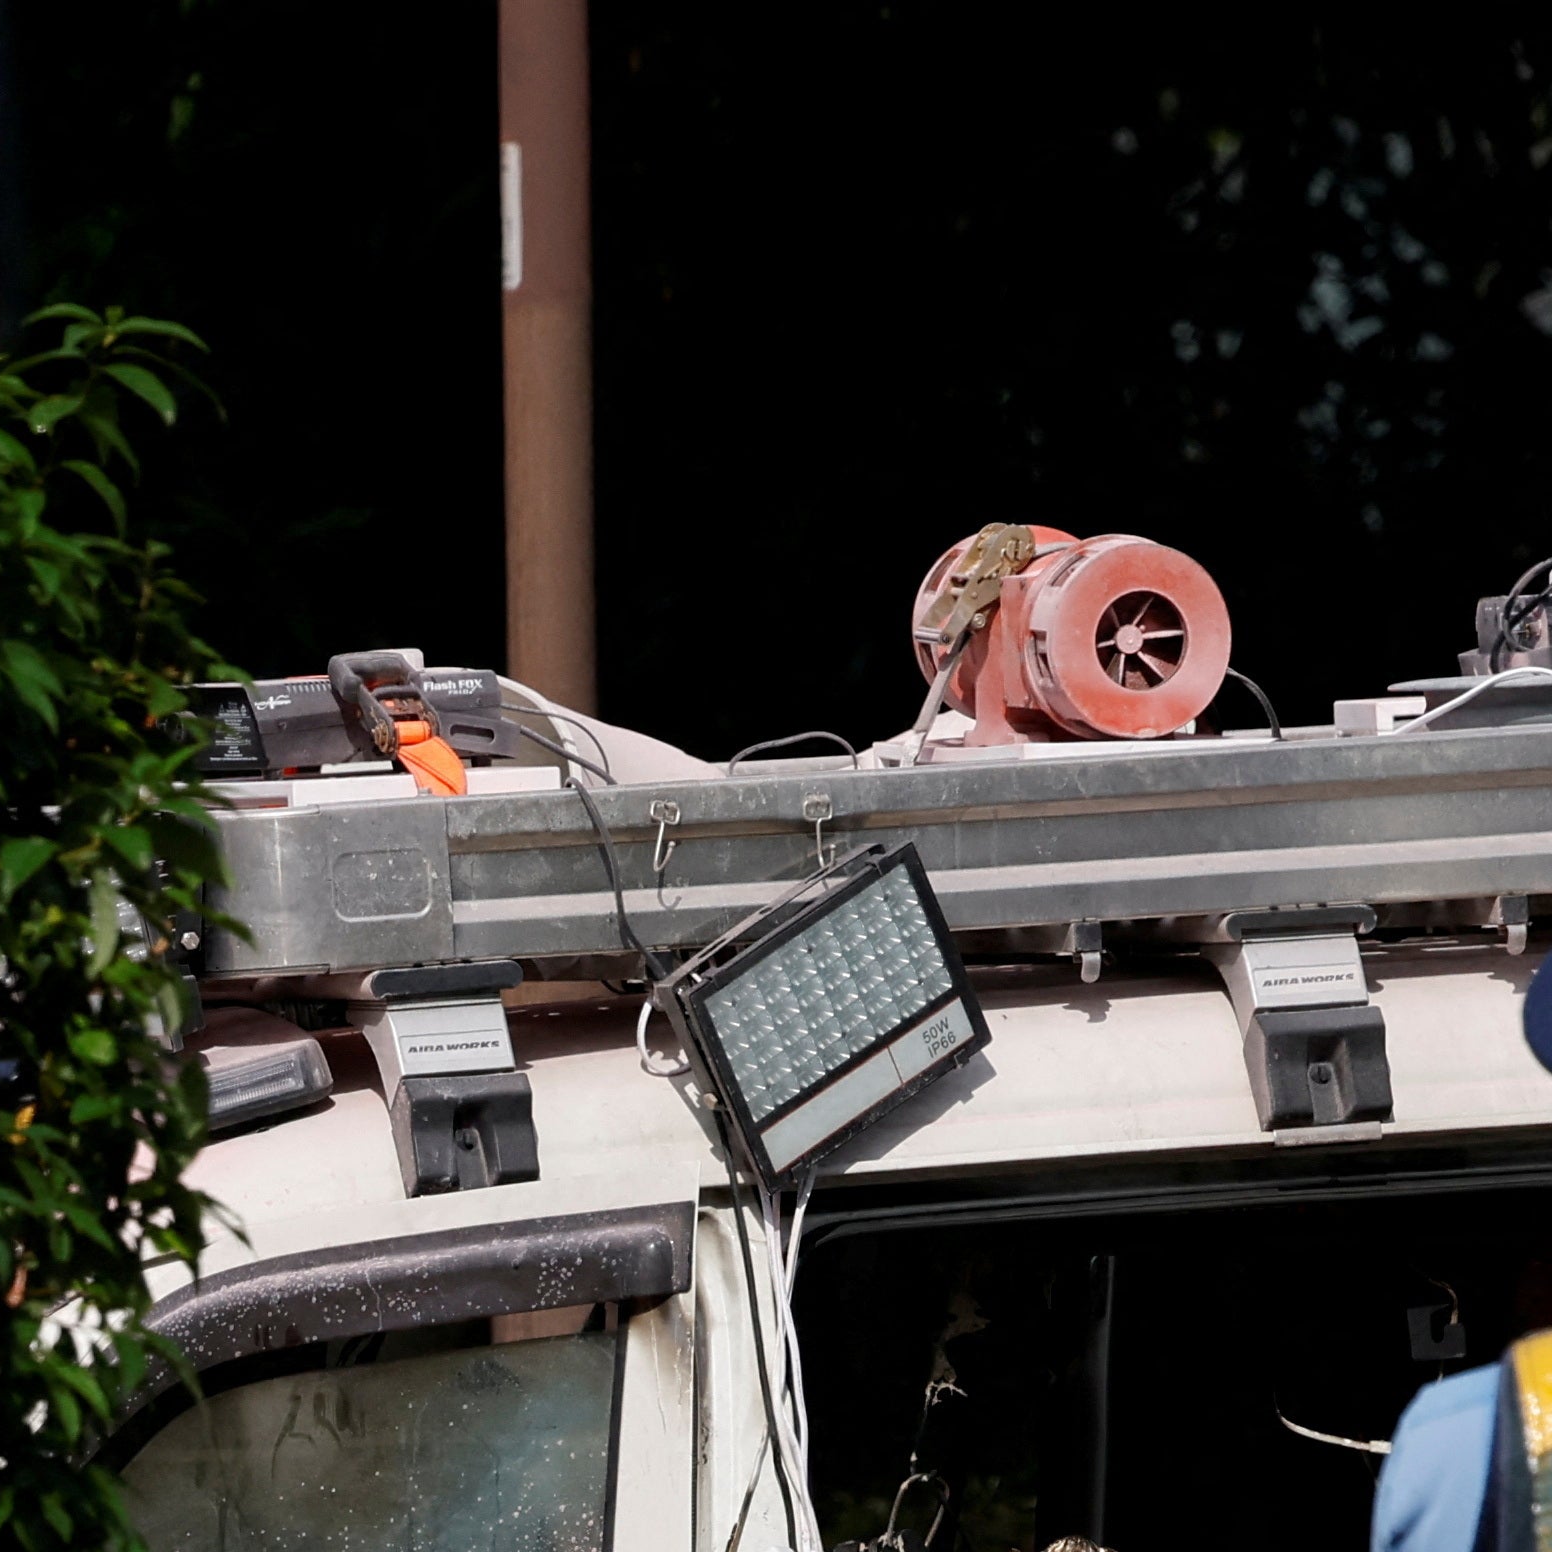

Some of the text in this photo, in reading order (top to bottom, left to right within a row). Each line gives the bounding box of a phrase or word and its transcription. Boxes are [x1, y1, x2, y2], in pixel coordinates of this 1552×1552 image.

[423, 678, 483, 693] Flash FOX
[922, 1016, 949, 1044] 50W
[928, 1031, 956, 1058] IP66
